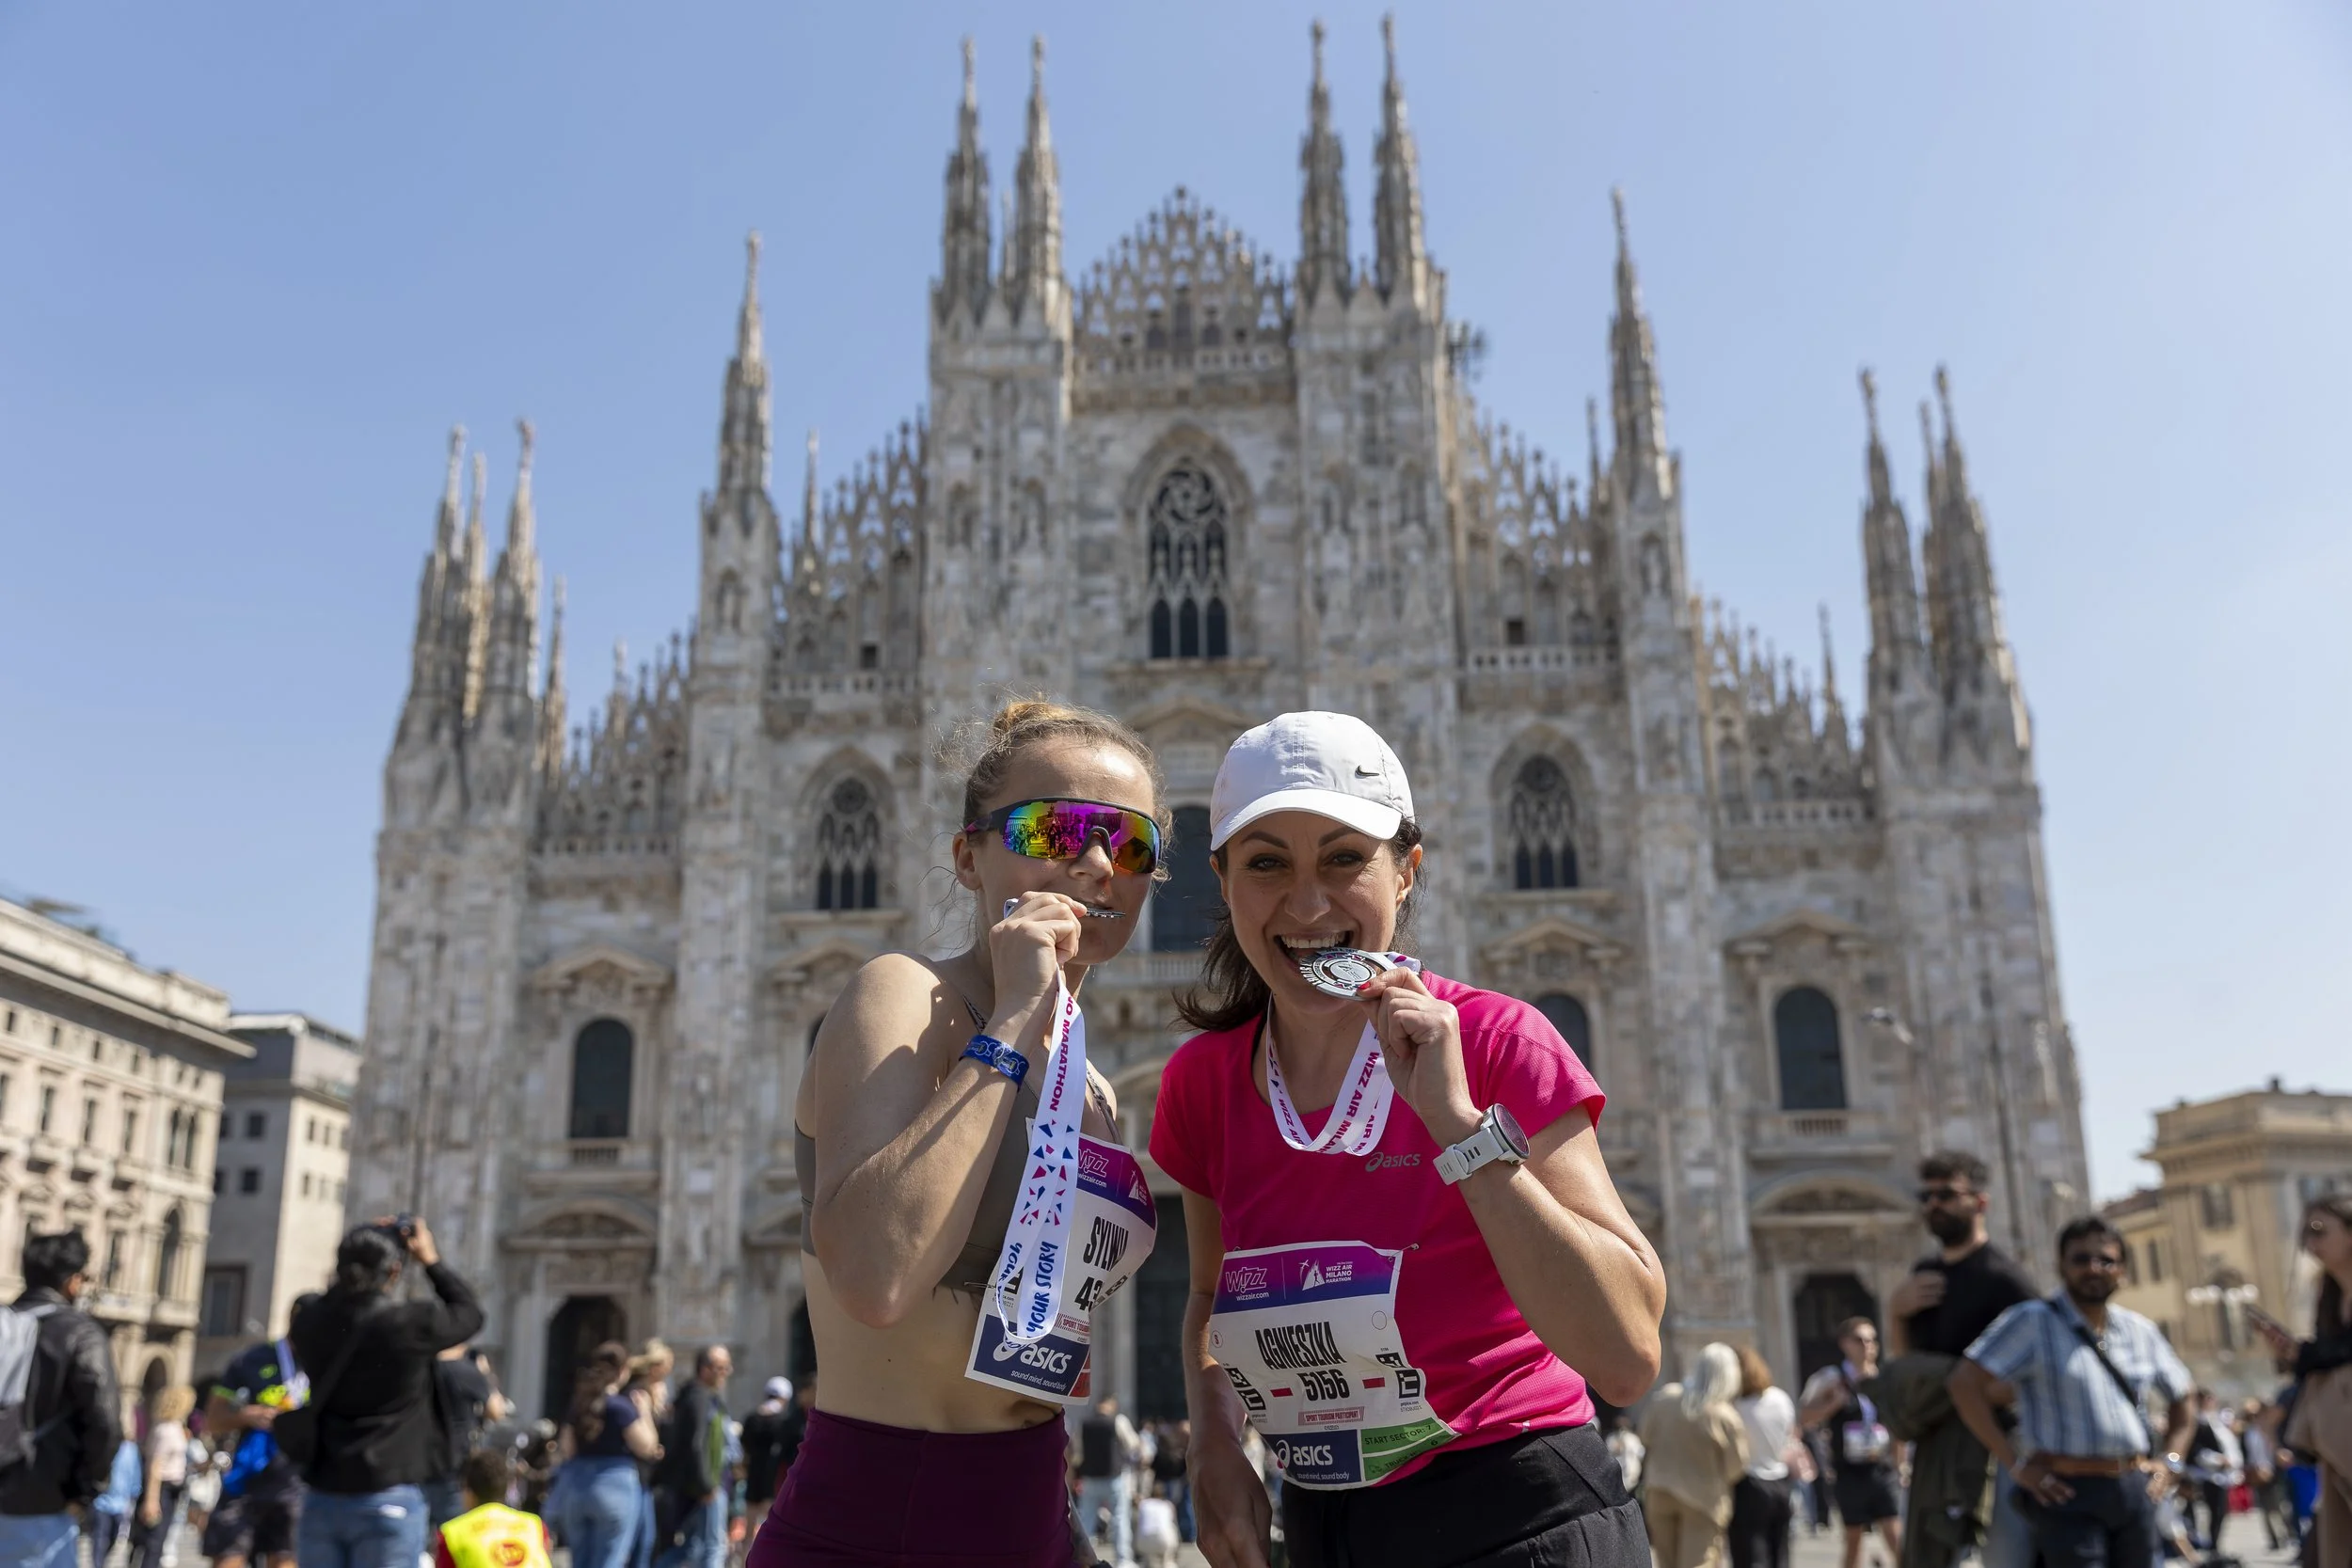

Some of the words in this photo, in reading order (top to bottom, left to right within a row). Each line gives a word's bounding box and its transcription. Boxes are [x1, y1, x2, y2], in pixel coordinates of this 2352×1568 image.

[1049, 1019, 1071, 1111] MARATHON
[1358, 1052, 1379, 1088] WIZZ
[1279, 1101, 1295, 1127] WIZZ
[1346, 1089, 1363, 1121] AIR
[1035, 1241, 1059, 1290] STORY
[1326, 1270, 1352, 1278] MILANO
[1236, 1291, 1270, 1301] wizzair.com
[1026, 1291, 1050, 1333] YOUR
[1020, 1342, 1073, 1375] asics
[1254, 1321, 1348, 1370] AGNIESZKA
[1010, 1370, 1030, 1381] sound
[1296, 1369, 1350, 1402] 5156
[1305, 1414, 1318, 1422] SPORT
[1318, 1413, 1335, 1421] TOURISM
[1335, 1410, 1359, 1419] PARTICIPANT
[1364, 1434, 1388, 1446] START
[1391, 1426, 1426, 1443] SECTOR:
[1293, 1445, 1334, 1466] asics
[1335, 1471, 1350, 1481] body
